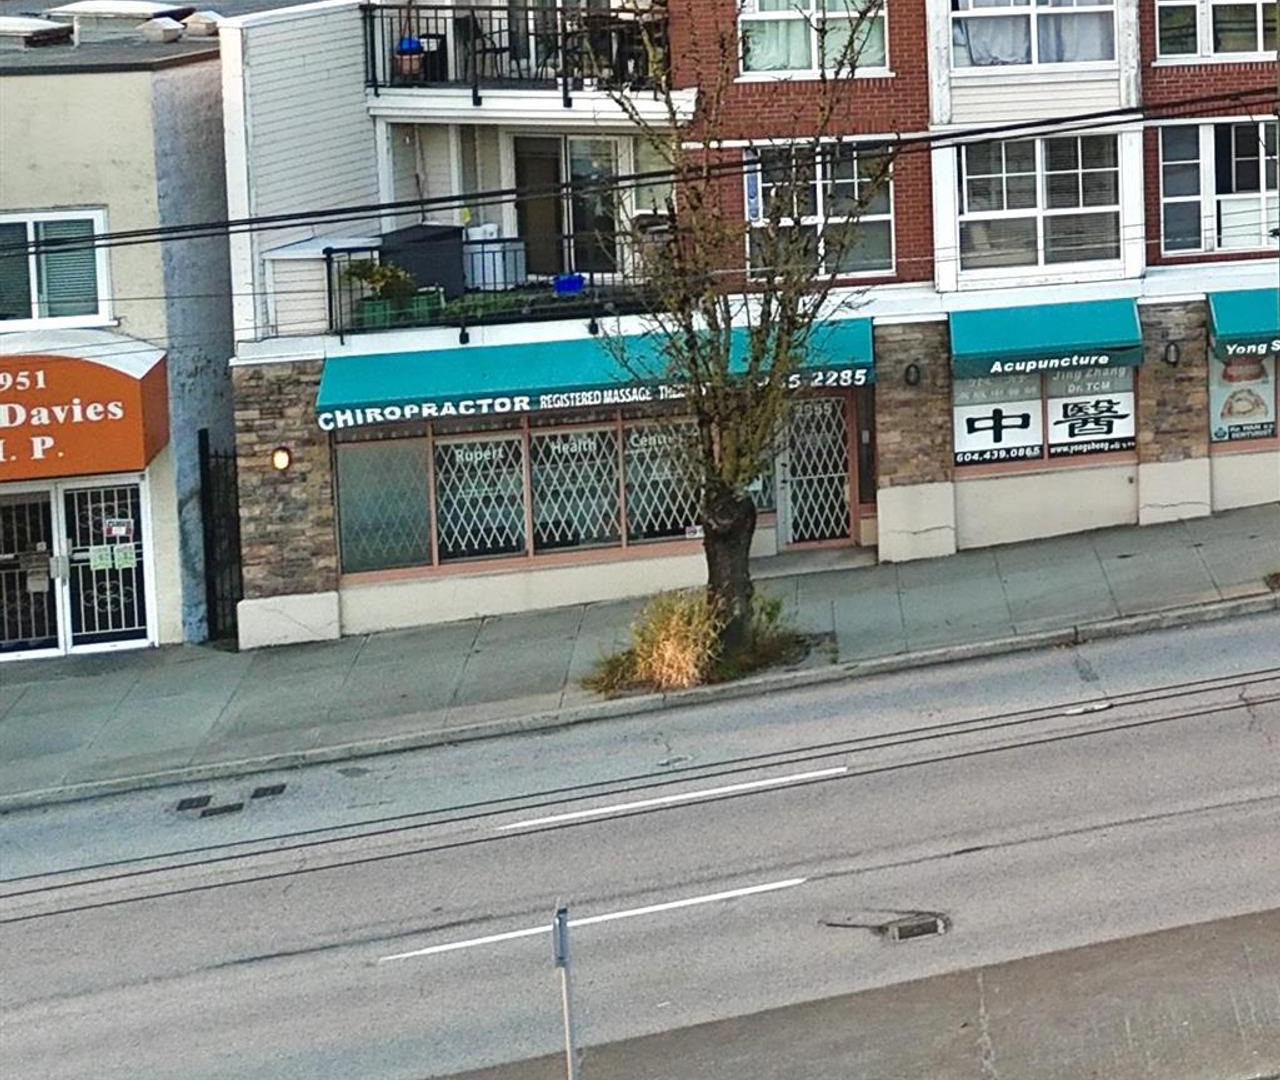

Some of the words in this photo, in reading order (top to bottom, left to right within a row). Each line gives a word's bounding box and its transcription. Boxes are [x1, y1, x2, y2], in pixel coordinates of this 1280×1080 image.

[1226, 342, 1268, 355] Yong
[990, 354, 1109, 374] Acupuncture
[0, 370, 46, 391] 951
[810, 369, 868, 387] 2285
[1052, 368, 1082, 381] Jing
[1086, 381, 1111, 391] TCM
[0, 397, 124, 428] Davies
[318, 395, 530, 431] CHIROPRACTOR
[540, 390, 600, 409] REGISTERED
[31, 436, 64, 460] P.
[456, 446, 504, 464] Rupert
[551, 437, 597, 454] Health
[956, 446, 1040, 463] 604.439.0865
